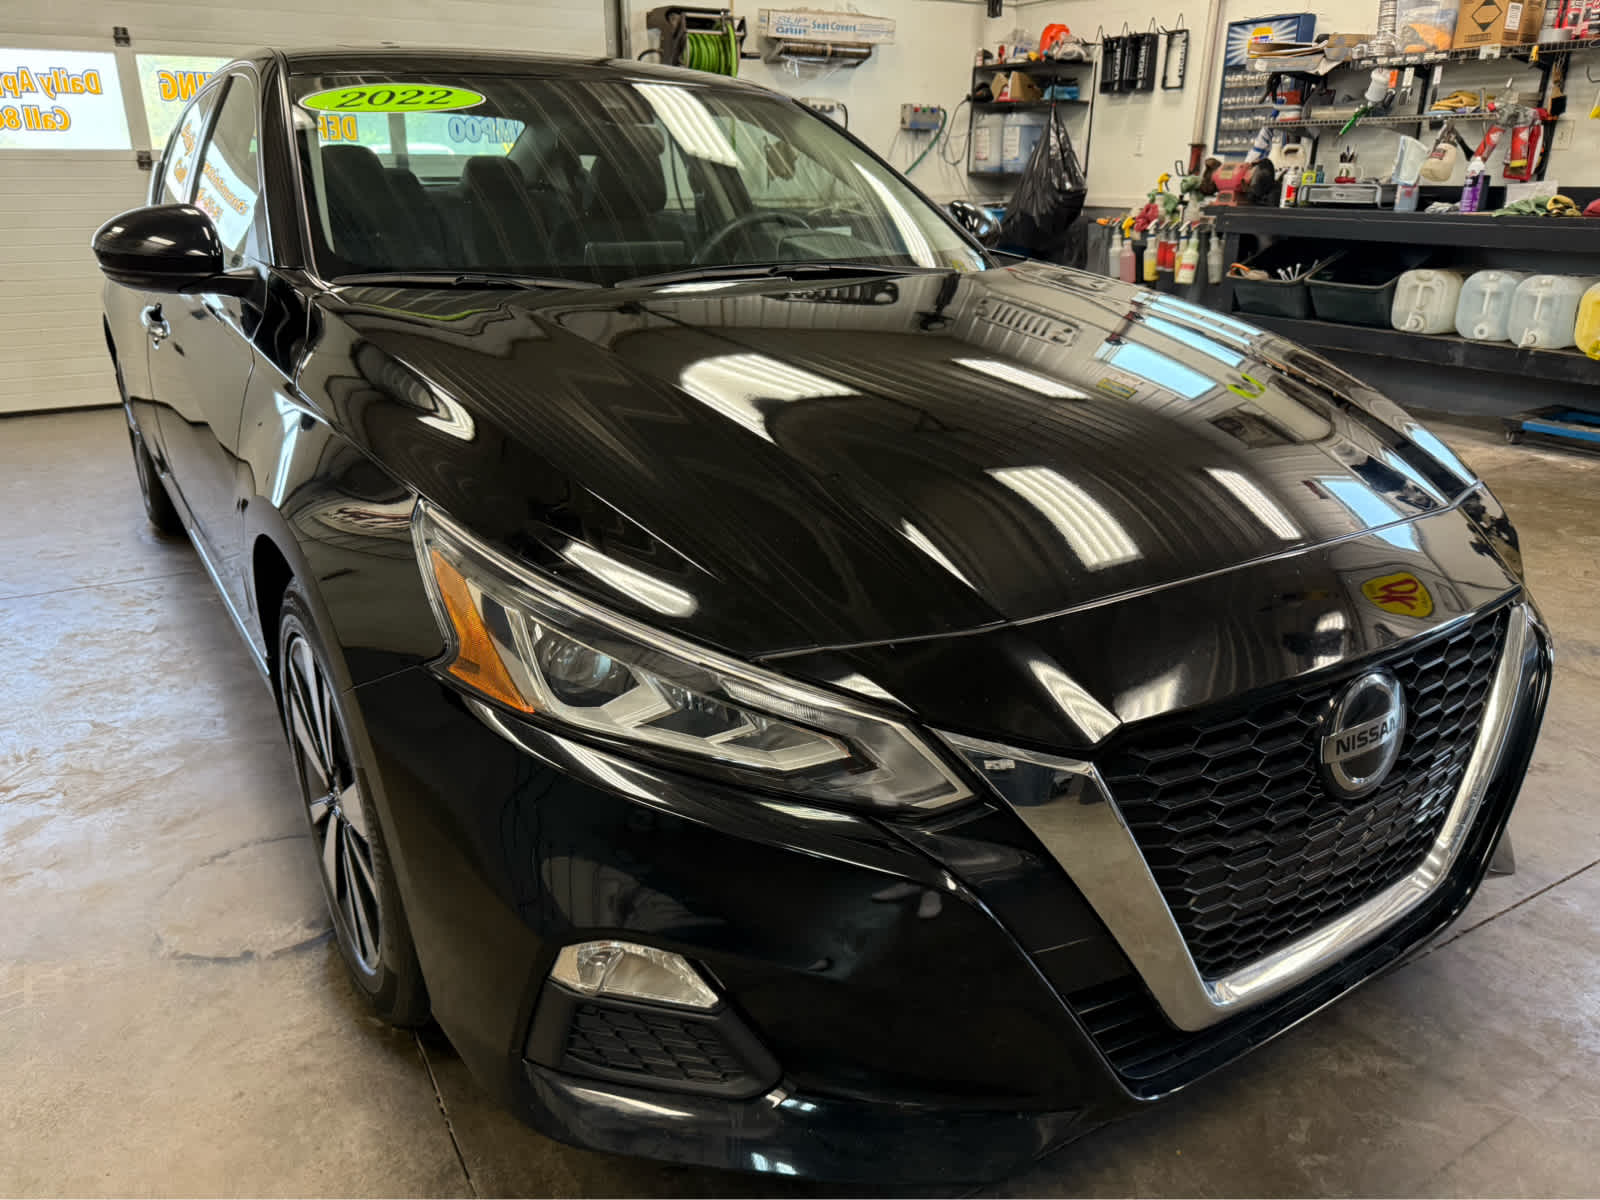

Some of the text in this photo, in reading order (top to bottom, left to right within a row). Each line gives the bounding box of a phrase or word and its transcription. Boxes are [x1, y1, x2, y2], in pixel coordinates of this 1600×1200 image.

[811, 20, 830, 31] Seat
[334, 88, 454, 108] 2022
[1336, 717, 1397, 756] NISSAN
